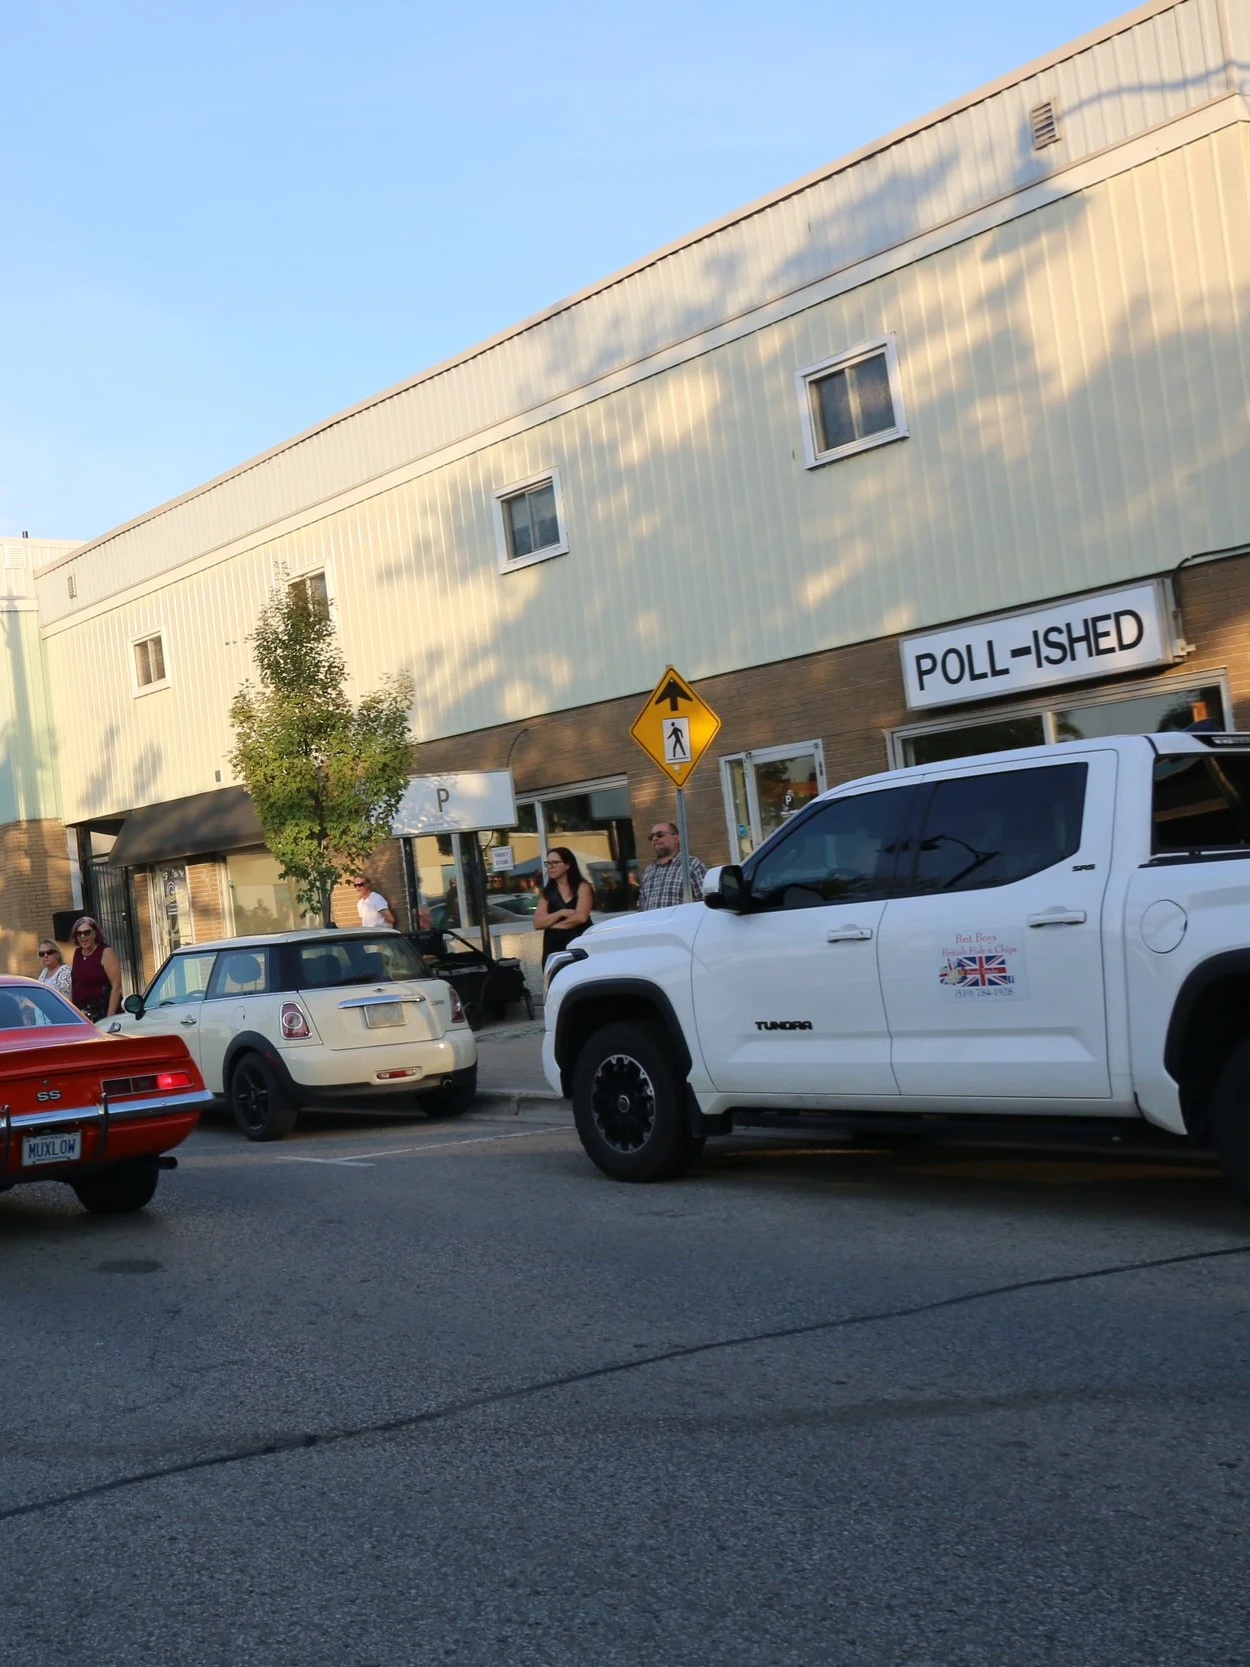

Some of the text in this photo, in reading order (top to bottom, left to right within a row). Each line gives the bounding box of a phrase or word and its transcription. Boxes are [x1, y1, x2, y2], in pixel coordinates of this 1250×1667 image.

[915, 609, 1144, 691] POLL-ISHED
[436, 788, 450, 812] P
[955, 932, 997, 944] Brit Boys
[942, 945, 967, 957] British
[969, 945, 985, 955] Fish
[994, 944, 1017, 955] Chips
[754, 1020, 813, 1031] TUNDRA
[37, 1090, 61, 1101] SS
[27, 1138, 77, 1159] MUXLOW
